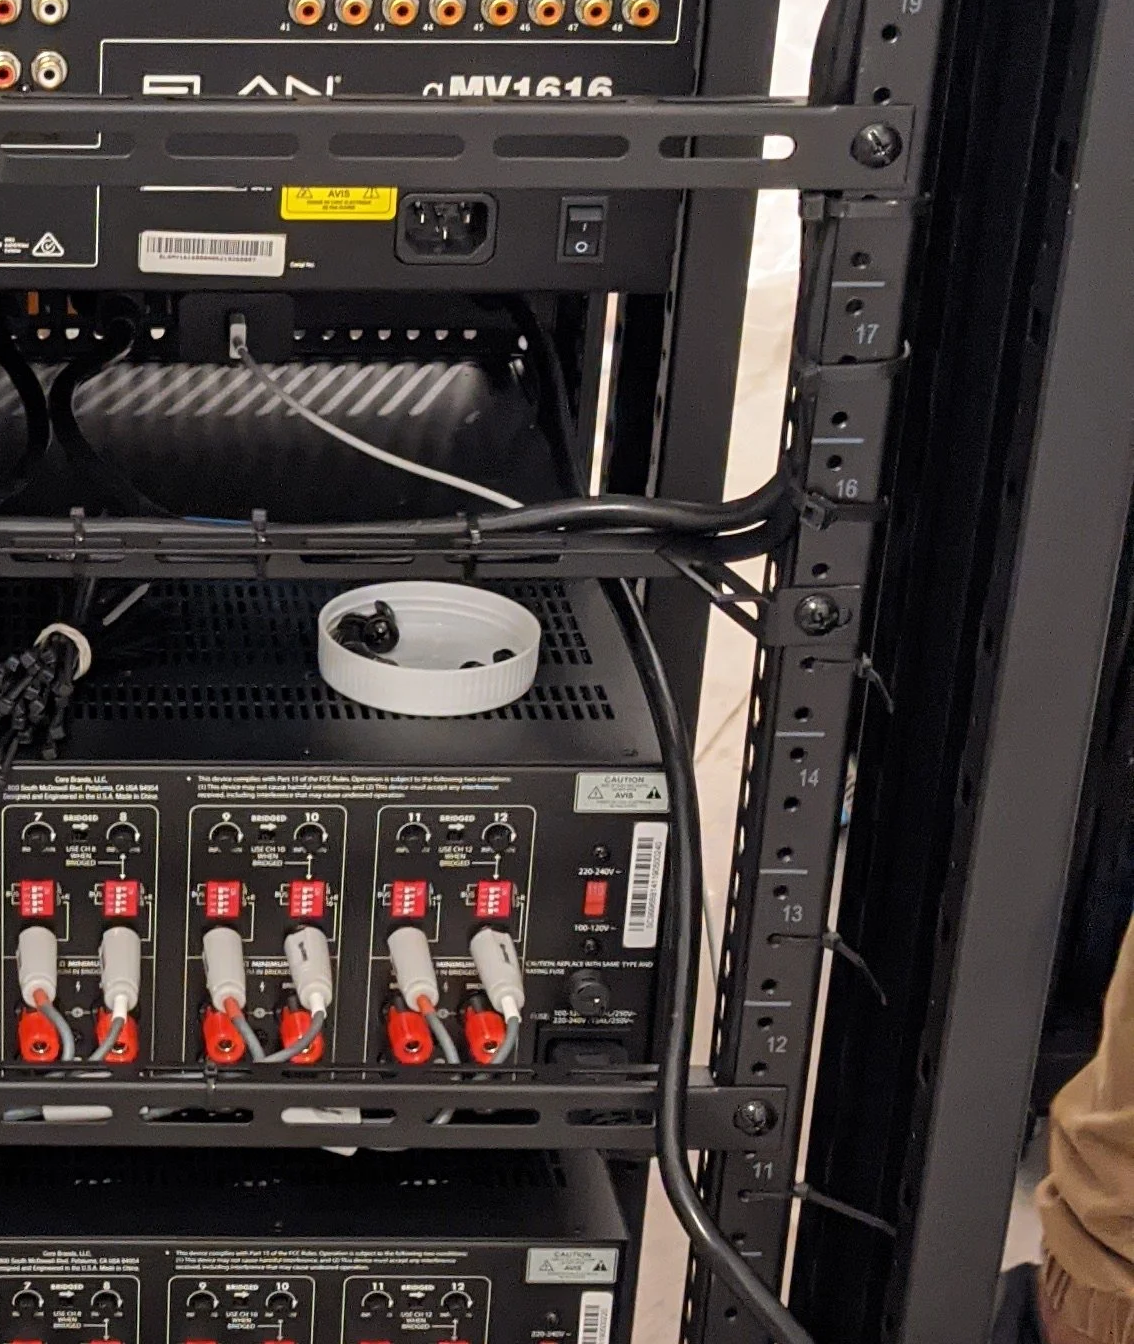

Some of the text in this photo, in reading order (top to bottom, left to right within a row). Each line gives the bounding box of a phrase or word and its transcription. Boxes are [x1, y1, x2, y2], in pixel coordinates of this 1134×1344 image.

[327, 189, 351, 199] AVIS
[856, 324, 879, 344] 17
[837, 479, 857, 497] 16
[800, 768, 819, 786] 14
[34, 812, 42, 821] 7
[119, 812, 127, 821] 8
[222, 812, 230, 821] 9
[305, 812, 319, 821] 10
[408, 812, 421, 821] 11
[494, 812, 508, 821] 12
[783, 905, 802, 922] 13
[768, 1036, 787, 1052] 12
[753, 1162, 772, 1178] 11
